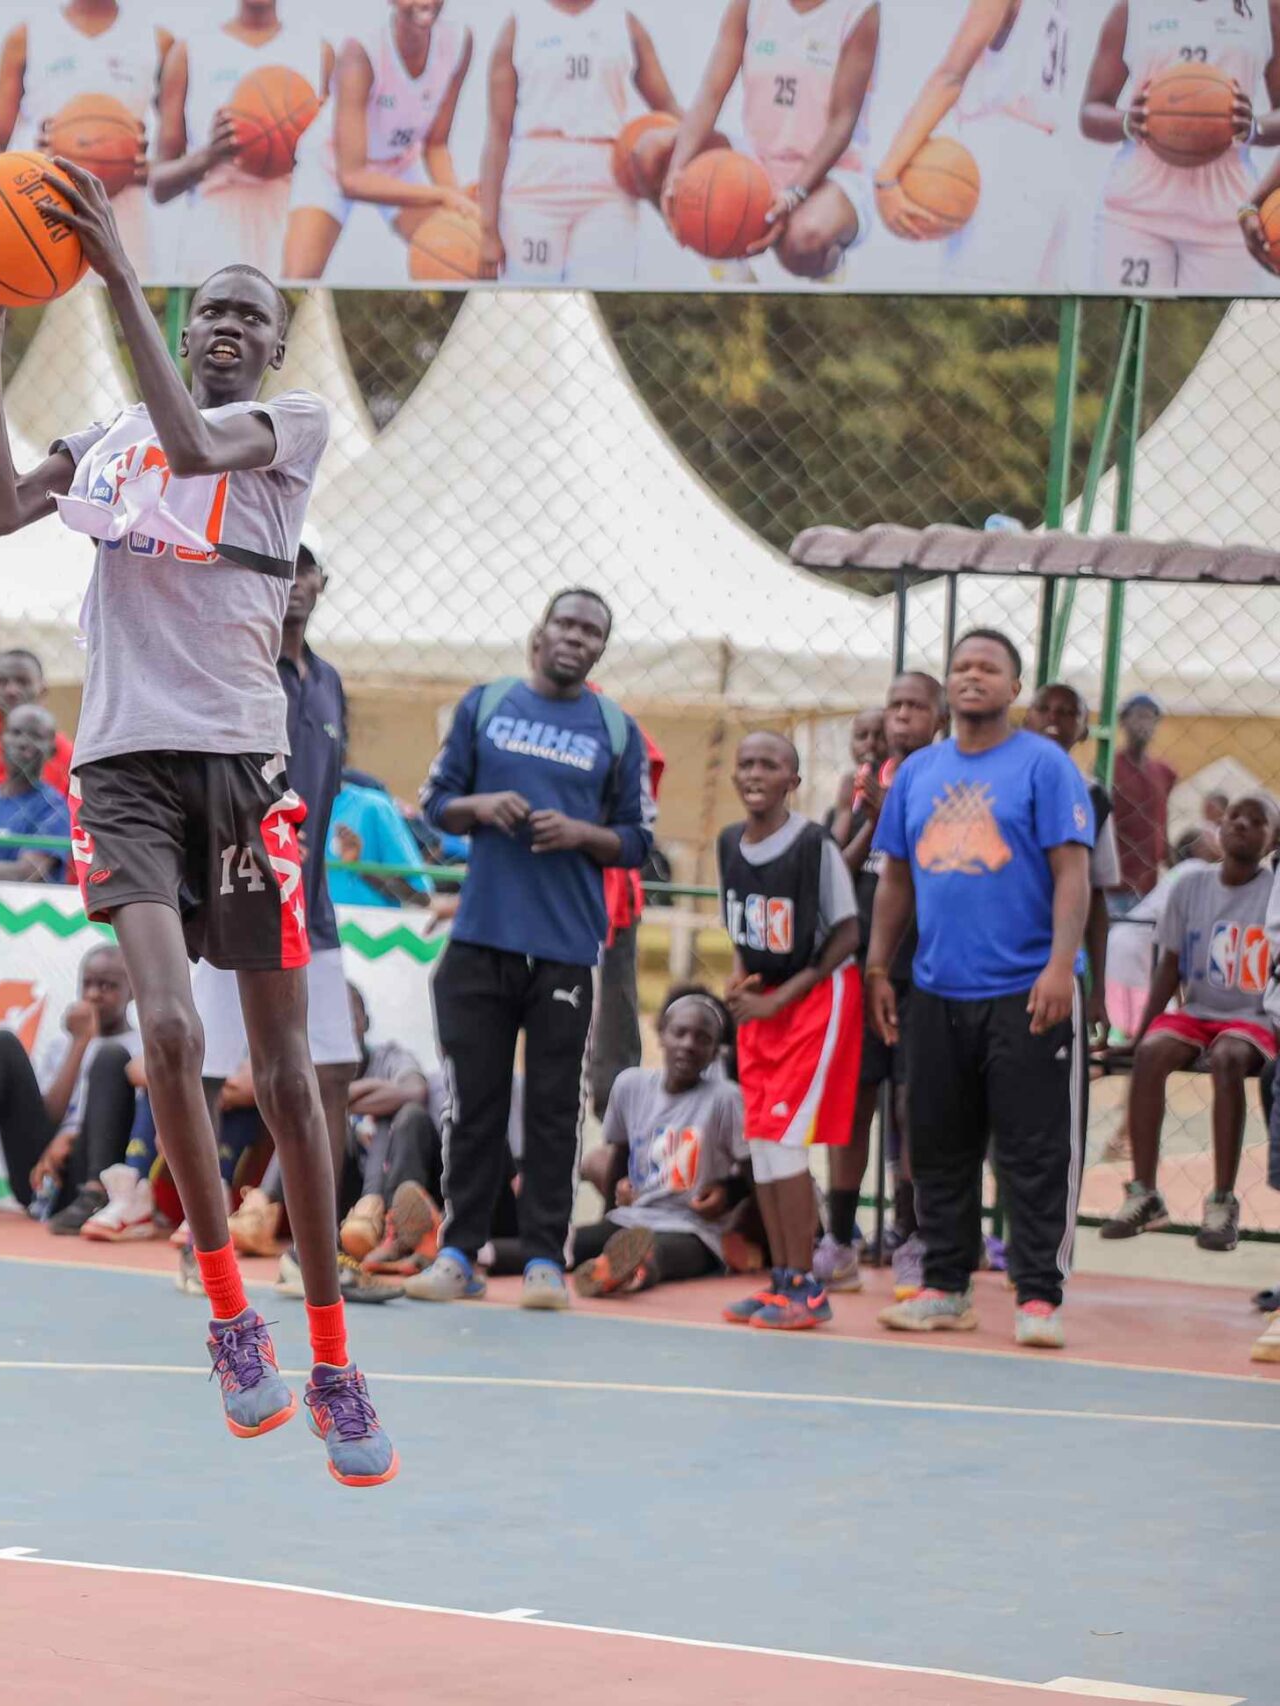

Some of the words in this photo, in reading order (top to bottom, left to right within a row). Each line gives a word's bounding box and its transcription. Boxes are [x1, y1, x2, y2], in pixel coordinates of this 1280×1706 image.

[566, 54, 589, 80] 30
[773, 75, 797, 106] 25
[522, 237, 548, 265] 30
[1120, 257, 1149, 288] 23
[93, 486, 110, 500] NBA
[131, 532, 150, 549] NBA
[220, 845, 266, 895] 14
